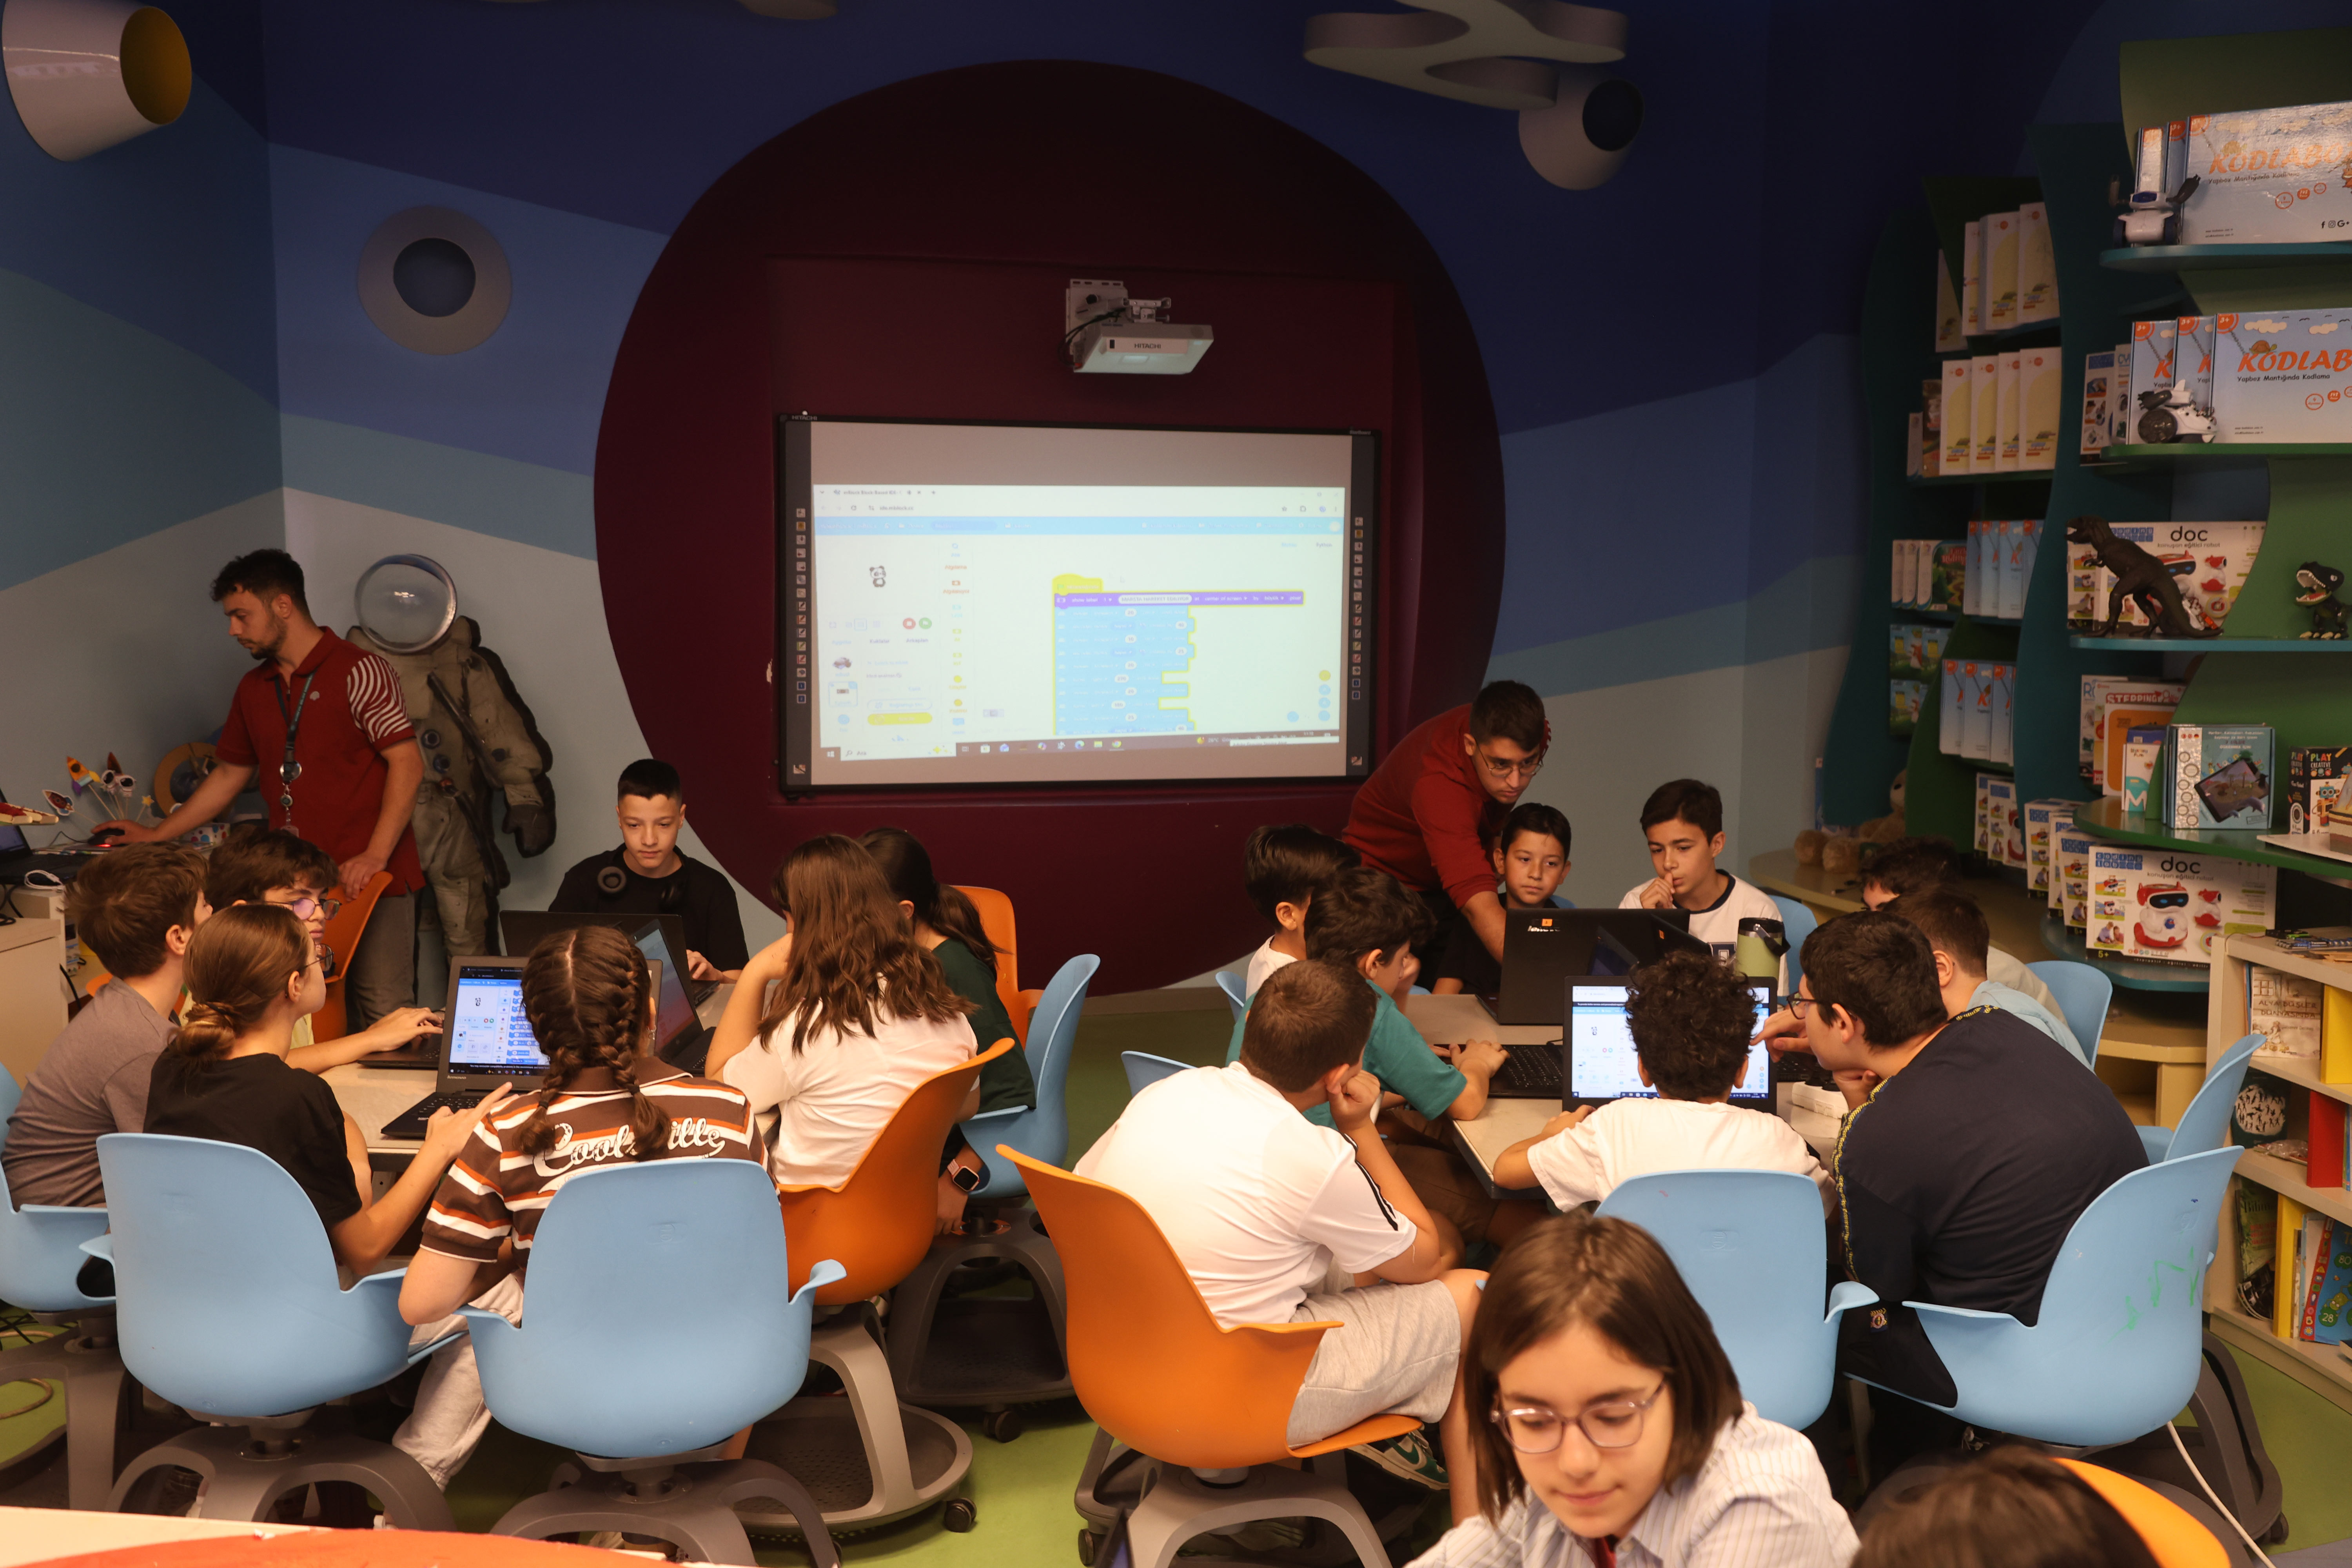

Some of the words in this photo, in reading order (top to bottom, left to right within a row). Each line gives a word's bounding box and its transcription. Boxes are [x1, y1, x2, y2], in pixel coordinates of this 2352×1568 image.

[2170, 526, 2208, 543] doc
[2310, 753, 2332, 761] PLAY
[2096, 852, 2143, 862] coding
[2161, 856, 2201, 874] doc
[2098, 950, 2110, 958] 5+
[2338, 1255, 2352, 1265] 80
[2323, 1312, 2334, 1323] 28
